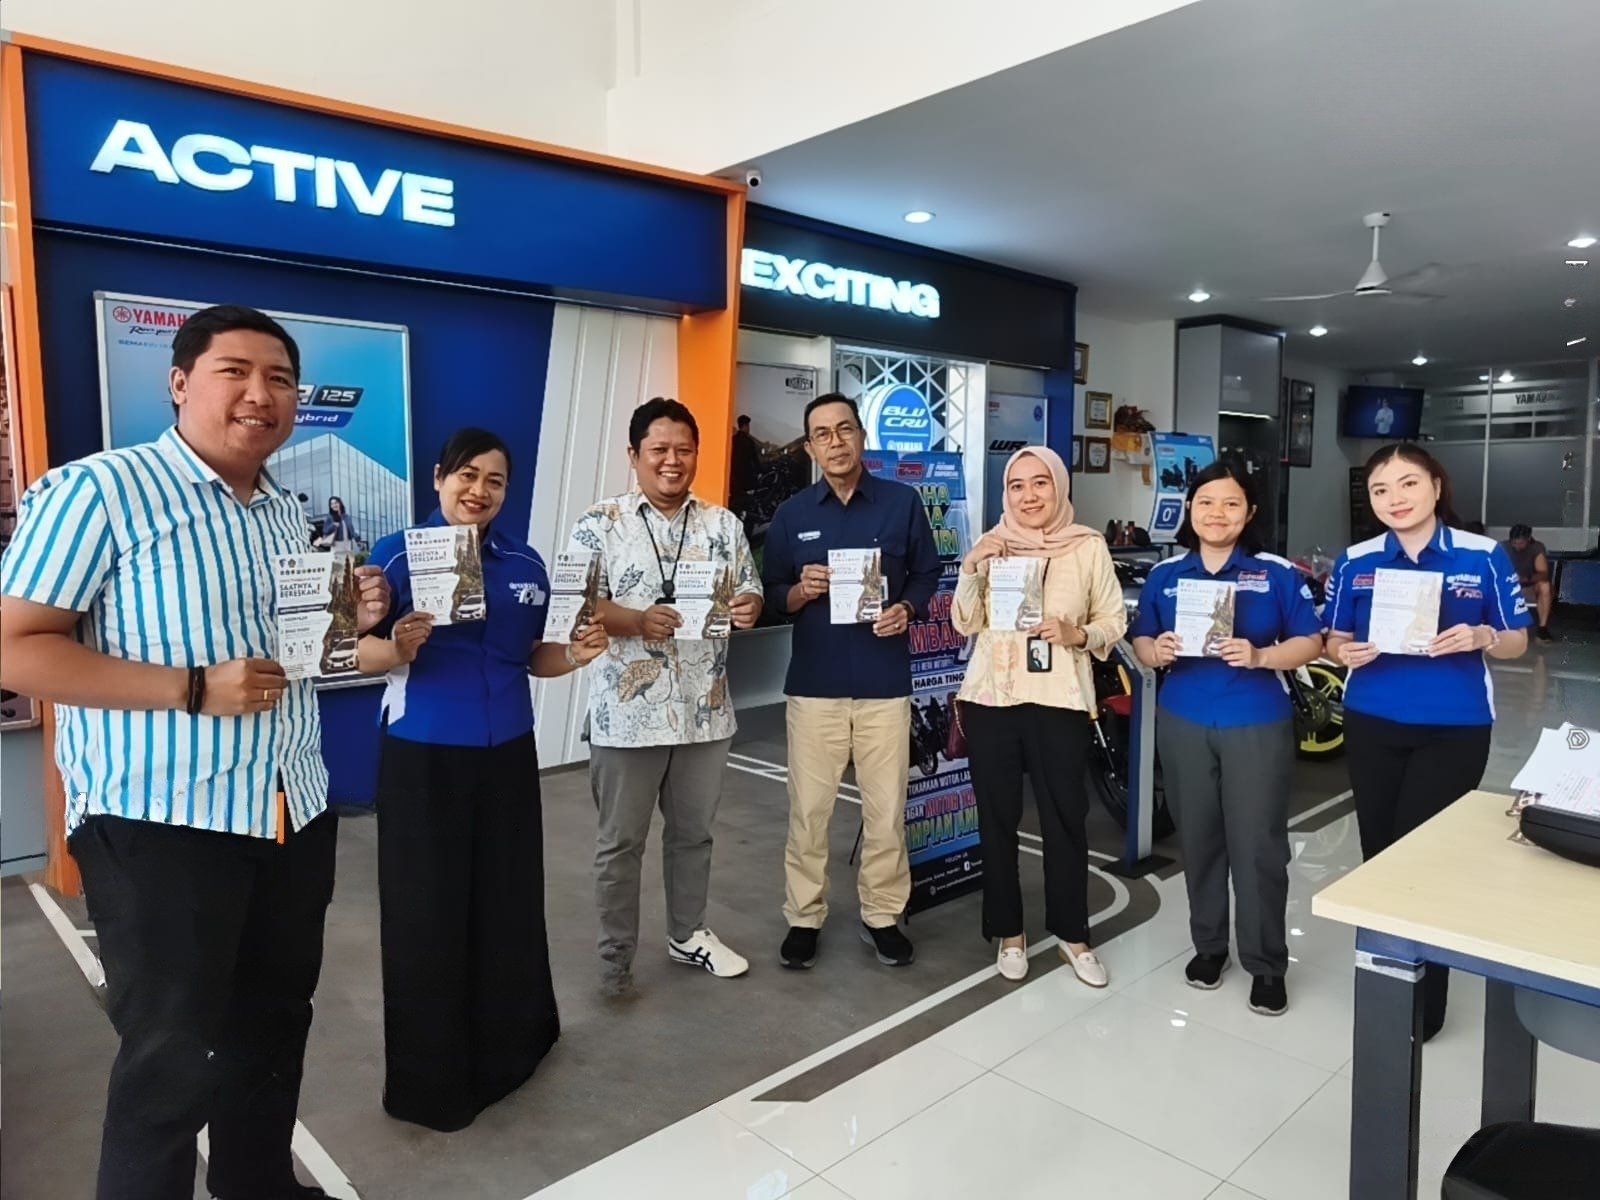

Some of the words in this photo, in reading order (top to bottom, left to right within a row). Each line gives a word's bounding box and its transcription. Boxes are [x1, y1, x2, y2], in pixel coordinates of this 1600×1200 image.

[89, 119, 455, 227] ACTIVE
[740, 248, 940, 318] EXCITING
[133, 308, 188, 327] YAMAH
[321, 389, 356, 402] 125
[882, 405, 926, 417] BLU
[294, 413, 338, 424] ybrid
[884, 417, 929, 428] CRU
[989, 440, 1028, 451] WR
[279, 582, 313, 591] SAATNYA
[279, 584, 320, 598] BERESKAN!
[914, 677, 943, 690] HARGA
